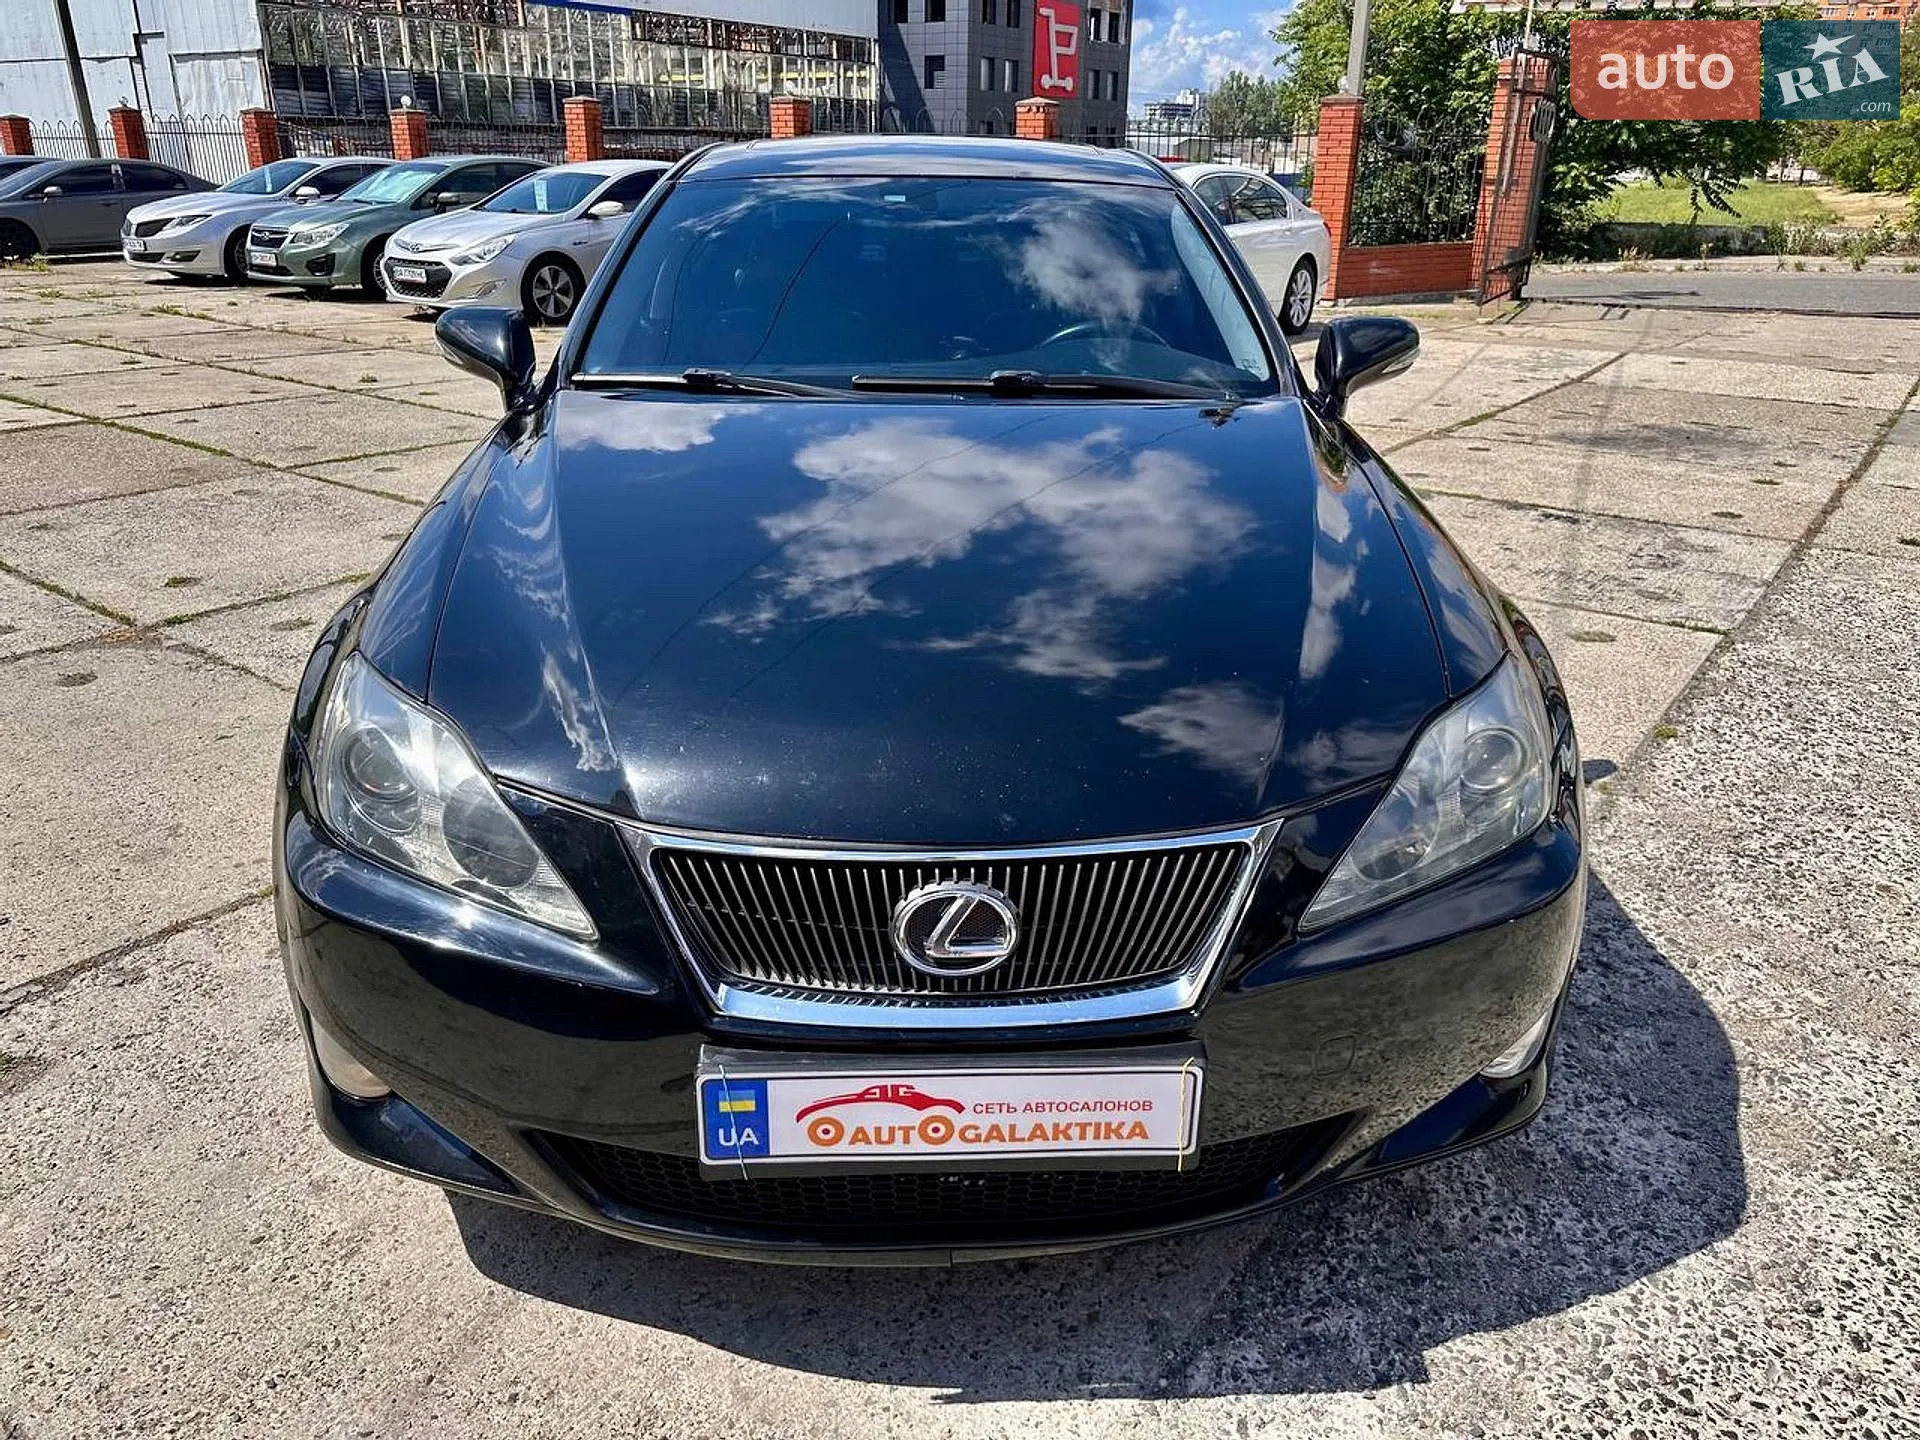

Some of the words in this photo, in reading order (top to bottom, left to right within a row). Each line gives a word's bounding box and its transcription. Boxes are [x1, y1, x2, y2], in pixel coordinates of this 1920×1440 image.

[973, 1102, 1017, 1115] СЕТЬ
[1022, 1100, 1153, 1114] АВТОСАЛОНОВ
[718, 1127, 760, 1147] UA
